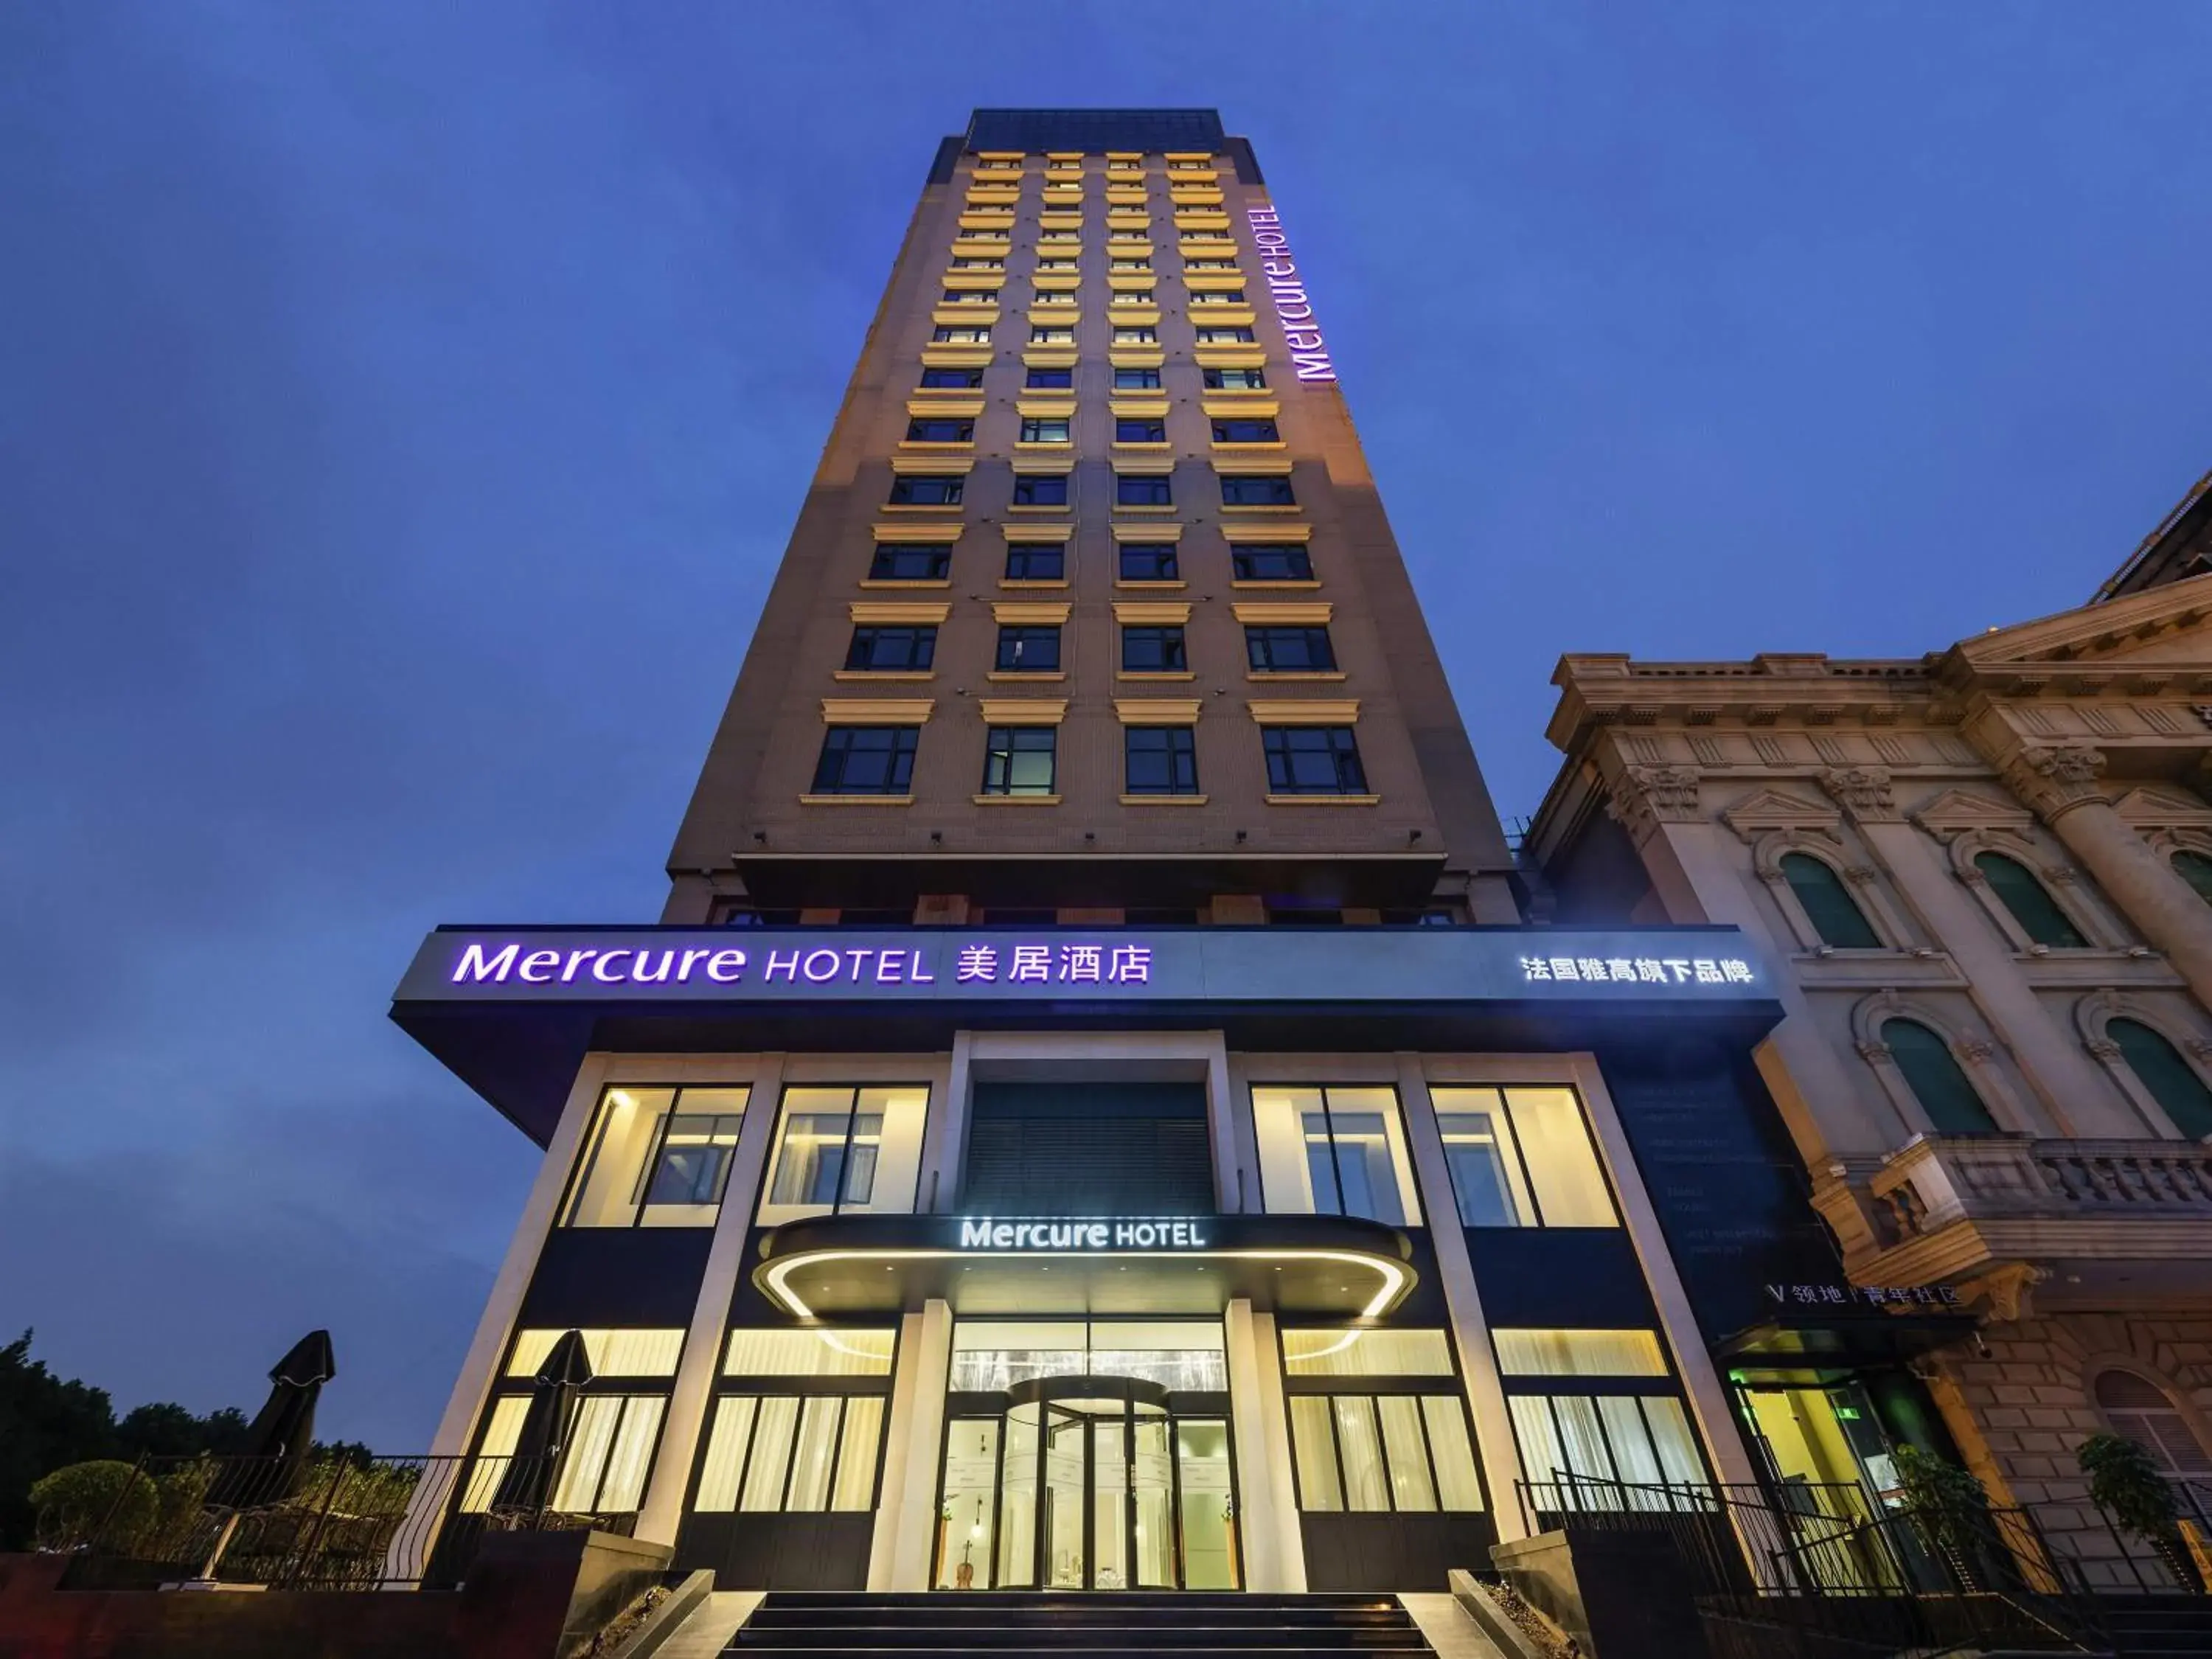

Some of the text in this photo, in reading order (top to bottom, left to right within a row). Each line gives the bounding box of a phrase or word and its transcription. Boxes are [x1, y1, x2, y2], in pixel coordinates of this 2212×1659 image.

[1247, 205, 1337, 383] Mercure HOTEL
[452, 945, 934, 982] Mercure HOTEL
[956, 945, 1151, 982] 美居酒店
[1520, 957, 1754, 983] 法国雅高旗下品牌
[960, 1220, 1206, 1248] Mercure HOTEL
